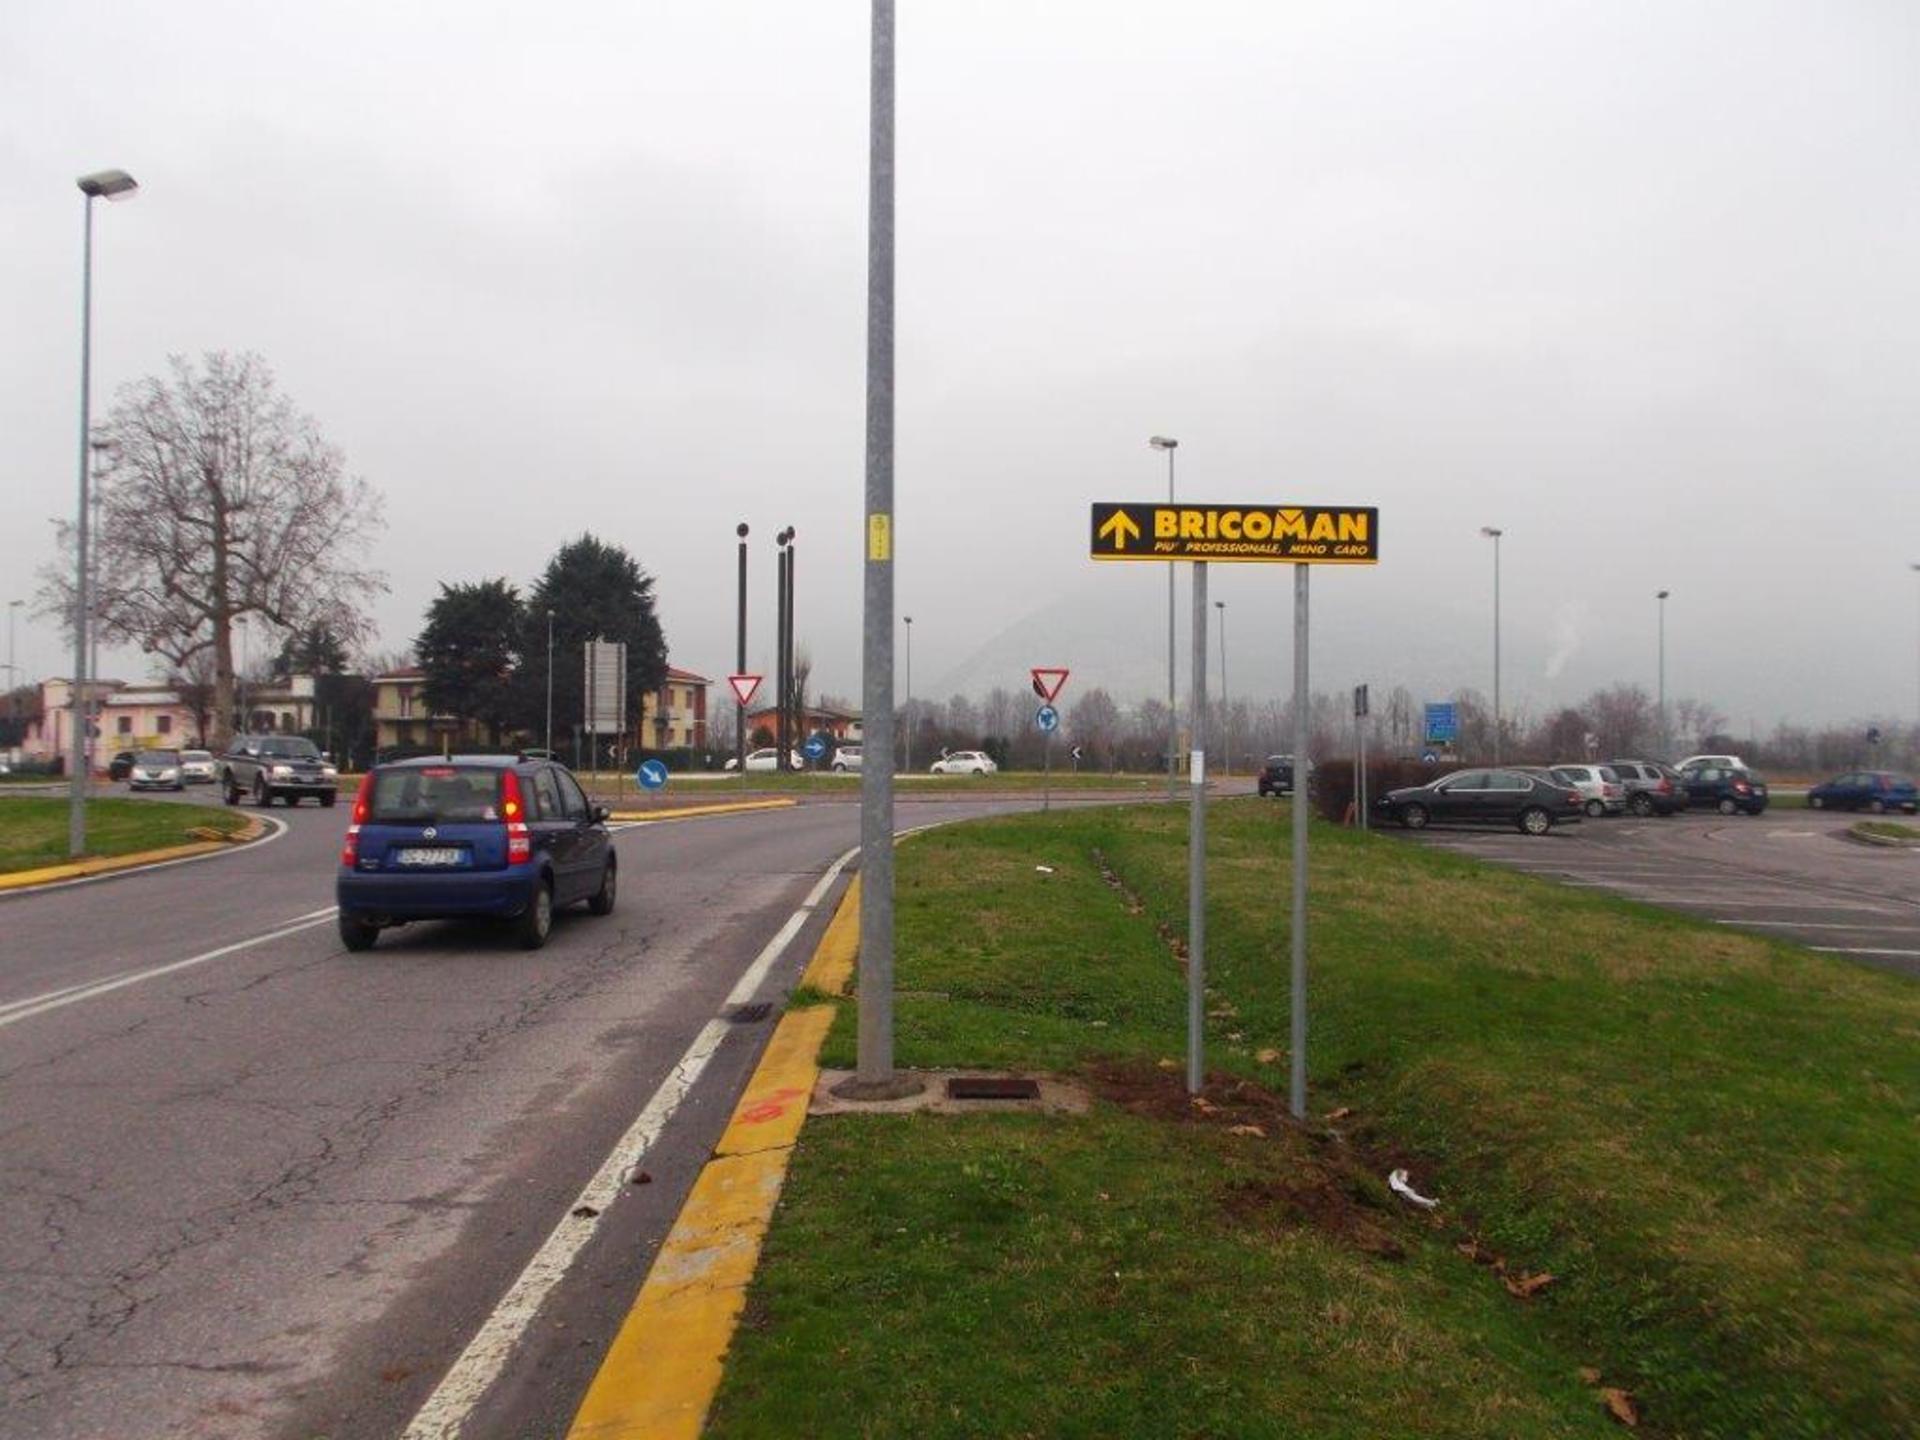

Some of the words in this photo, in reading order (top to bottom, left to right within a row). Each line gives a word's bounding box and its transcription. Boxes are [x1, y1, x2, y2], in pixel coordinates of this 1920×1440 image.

[1154, 509, 1368, 541] BRICOMAN
[1289, 544, 1327, 555] MENO
[1333, 545, 1368, 556] CARO
